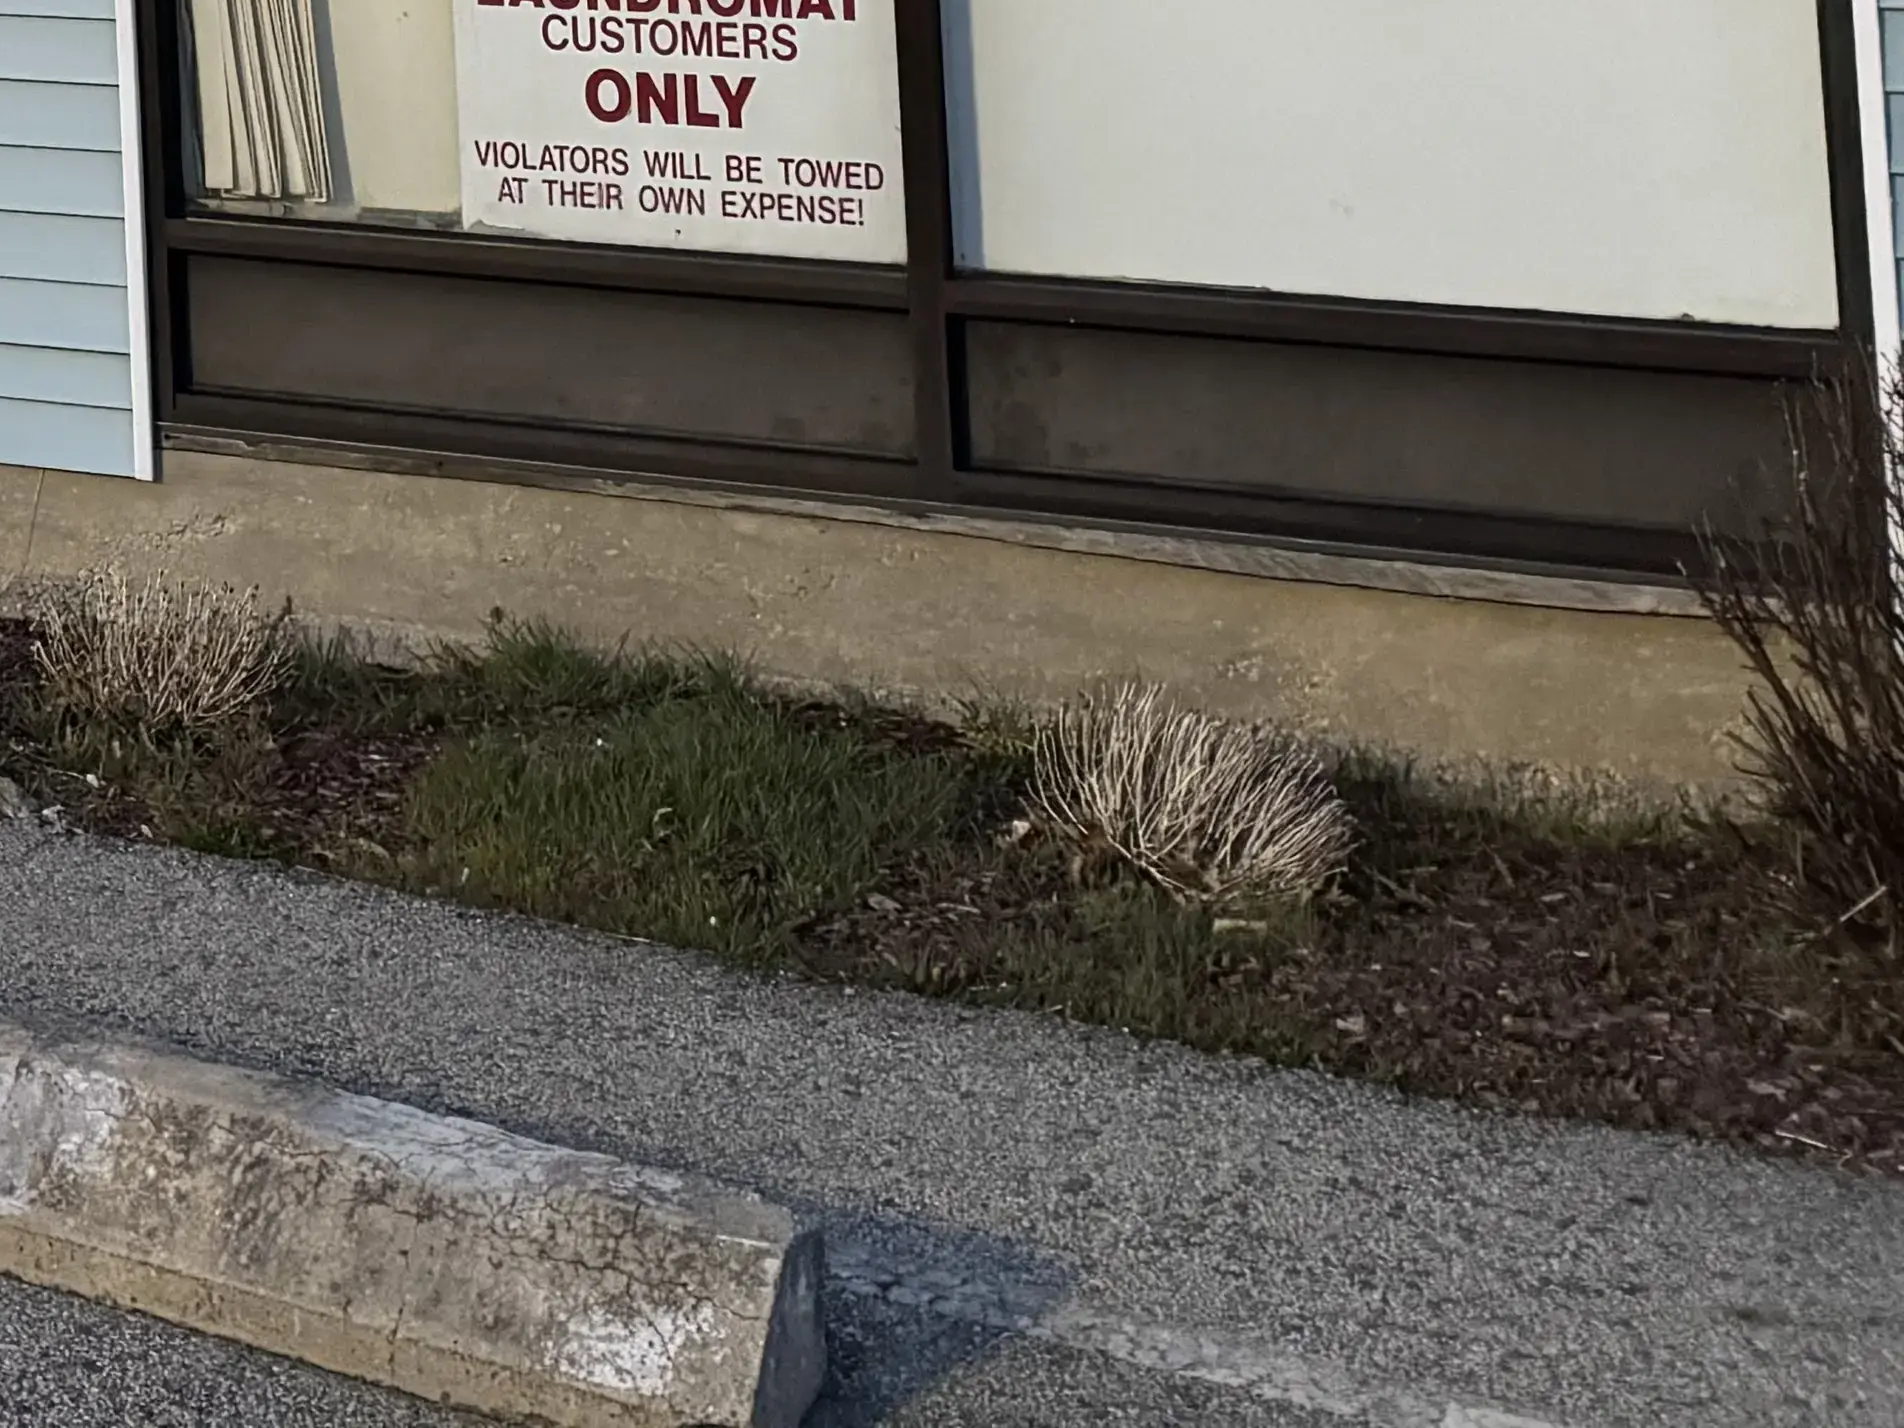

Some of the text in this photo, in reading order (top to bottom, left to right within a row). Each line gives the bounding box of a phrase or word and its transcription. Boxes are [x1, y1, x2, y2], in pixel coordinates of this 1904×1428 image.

[542, 14, 798, 61] CUSTOMERS
[585, 68, 757, 129] ONLY
[474, 140, 884, 191] VIOLATORS WILL BE TOWED
[498, 177, 865, 227] AT THEIR OWN EXPENSE!
